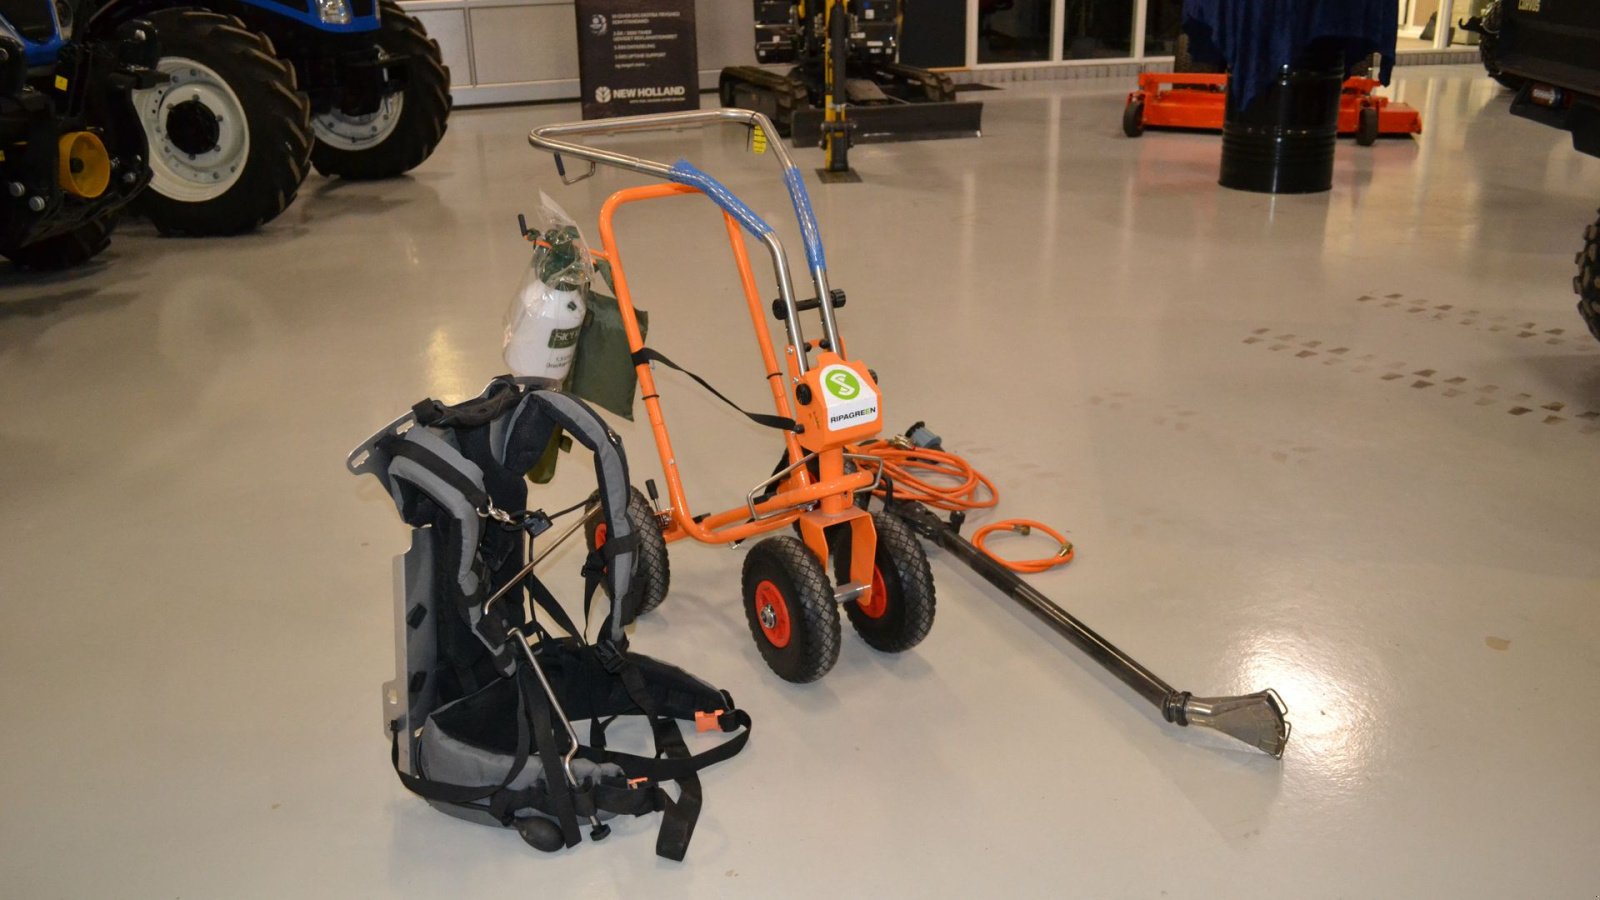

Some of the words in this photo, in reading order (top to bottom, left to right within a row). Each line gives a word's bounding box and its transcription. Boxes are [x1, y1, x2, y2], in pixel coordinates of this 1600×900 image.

[613, 88, 636, 99] NEW
[637, 85, 685, 97] HOLLAND
[830, 406, 876, 423] RIPAGREEN
